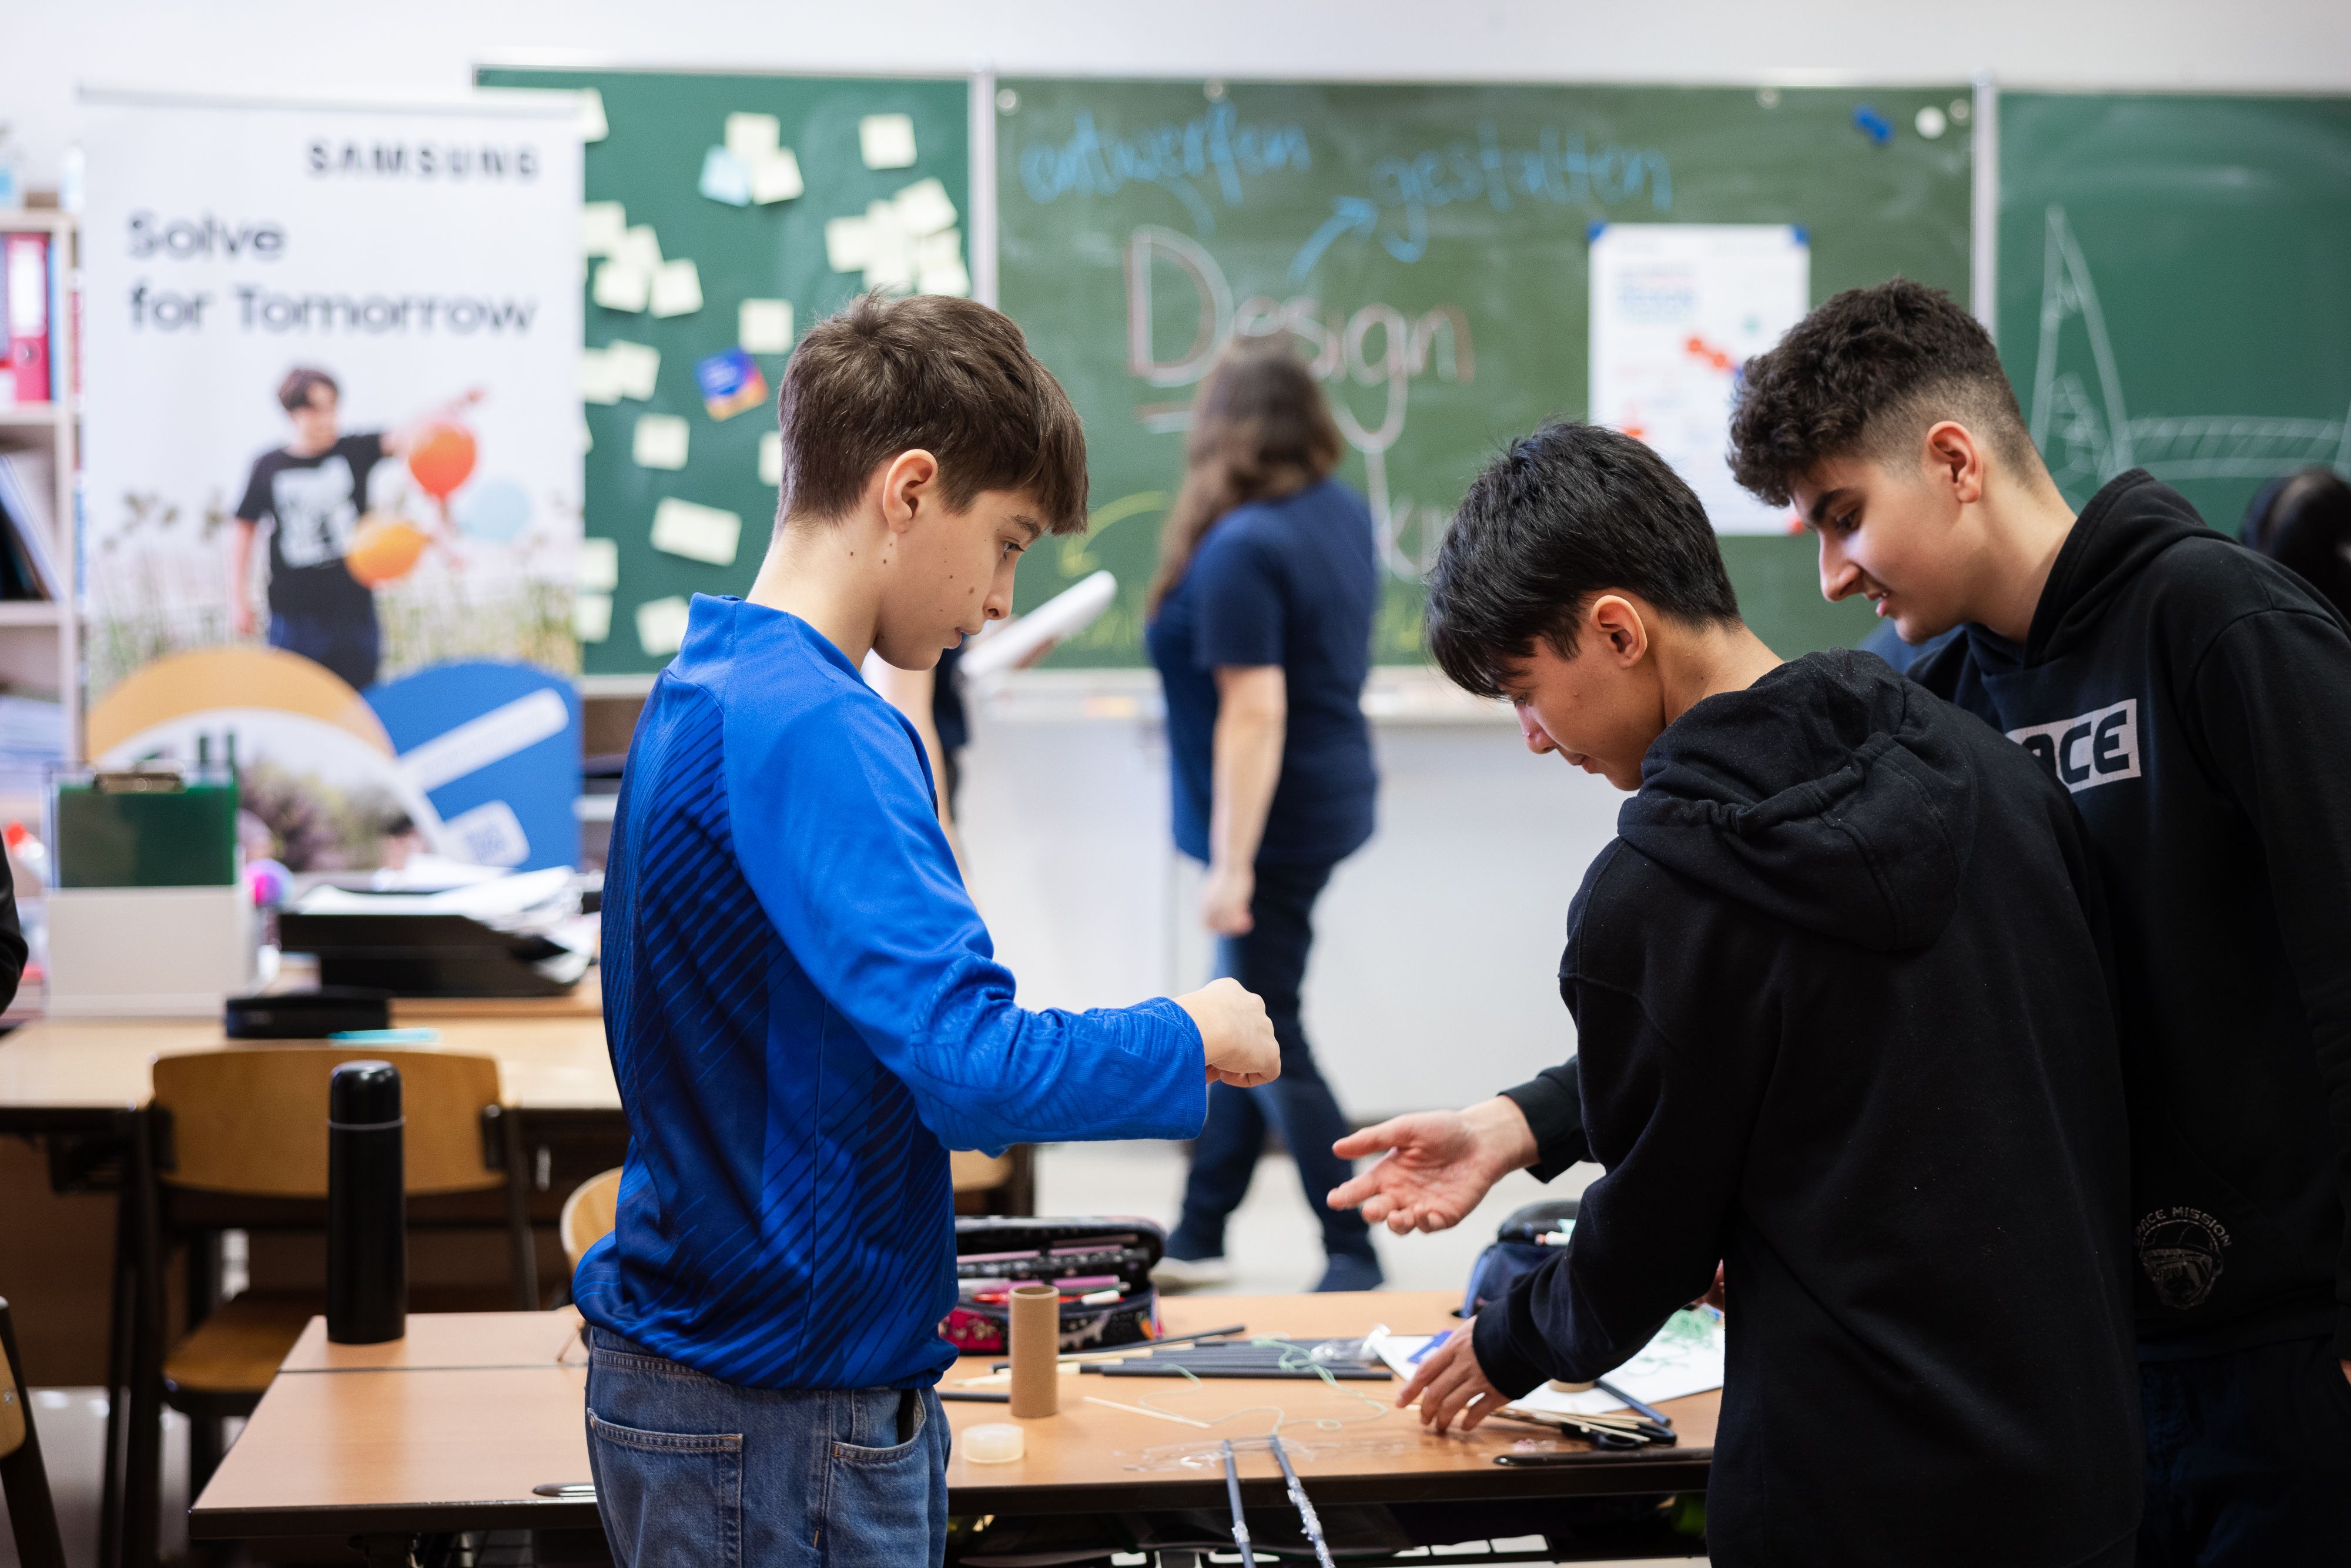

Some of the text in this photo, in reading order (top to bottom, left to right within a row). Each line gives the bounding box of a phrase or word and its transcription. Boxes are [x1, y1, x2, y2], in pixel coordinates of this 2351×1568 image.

[308, 140, 540, 179] SAMSUNG
[1371, 119, 1672, 262] gestalten
[128, 212, 284, 259] Solve
[131, 282, 537, 332] for Tomorrow
[2022, 708, 2130, 784] ACE
[2172, 1207, 2232, 1247] MISSION
